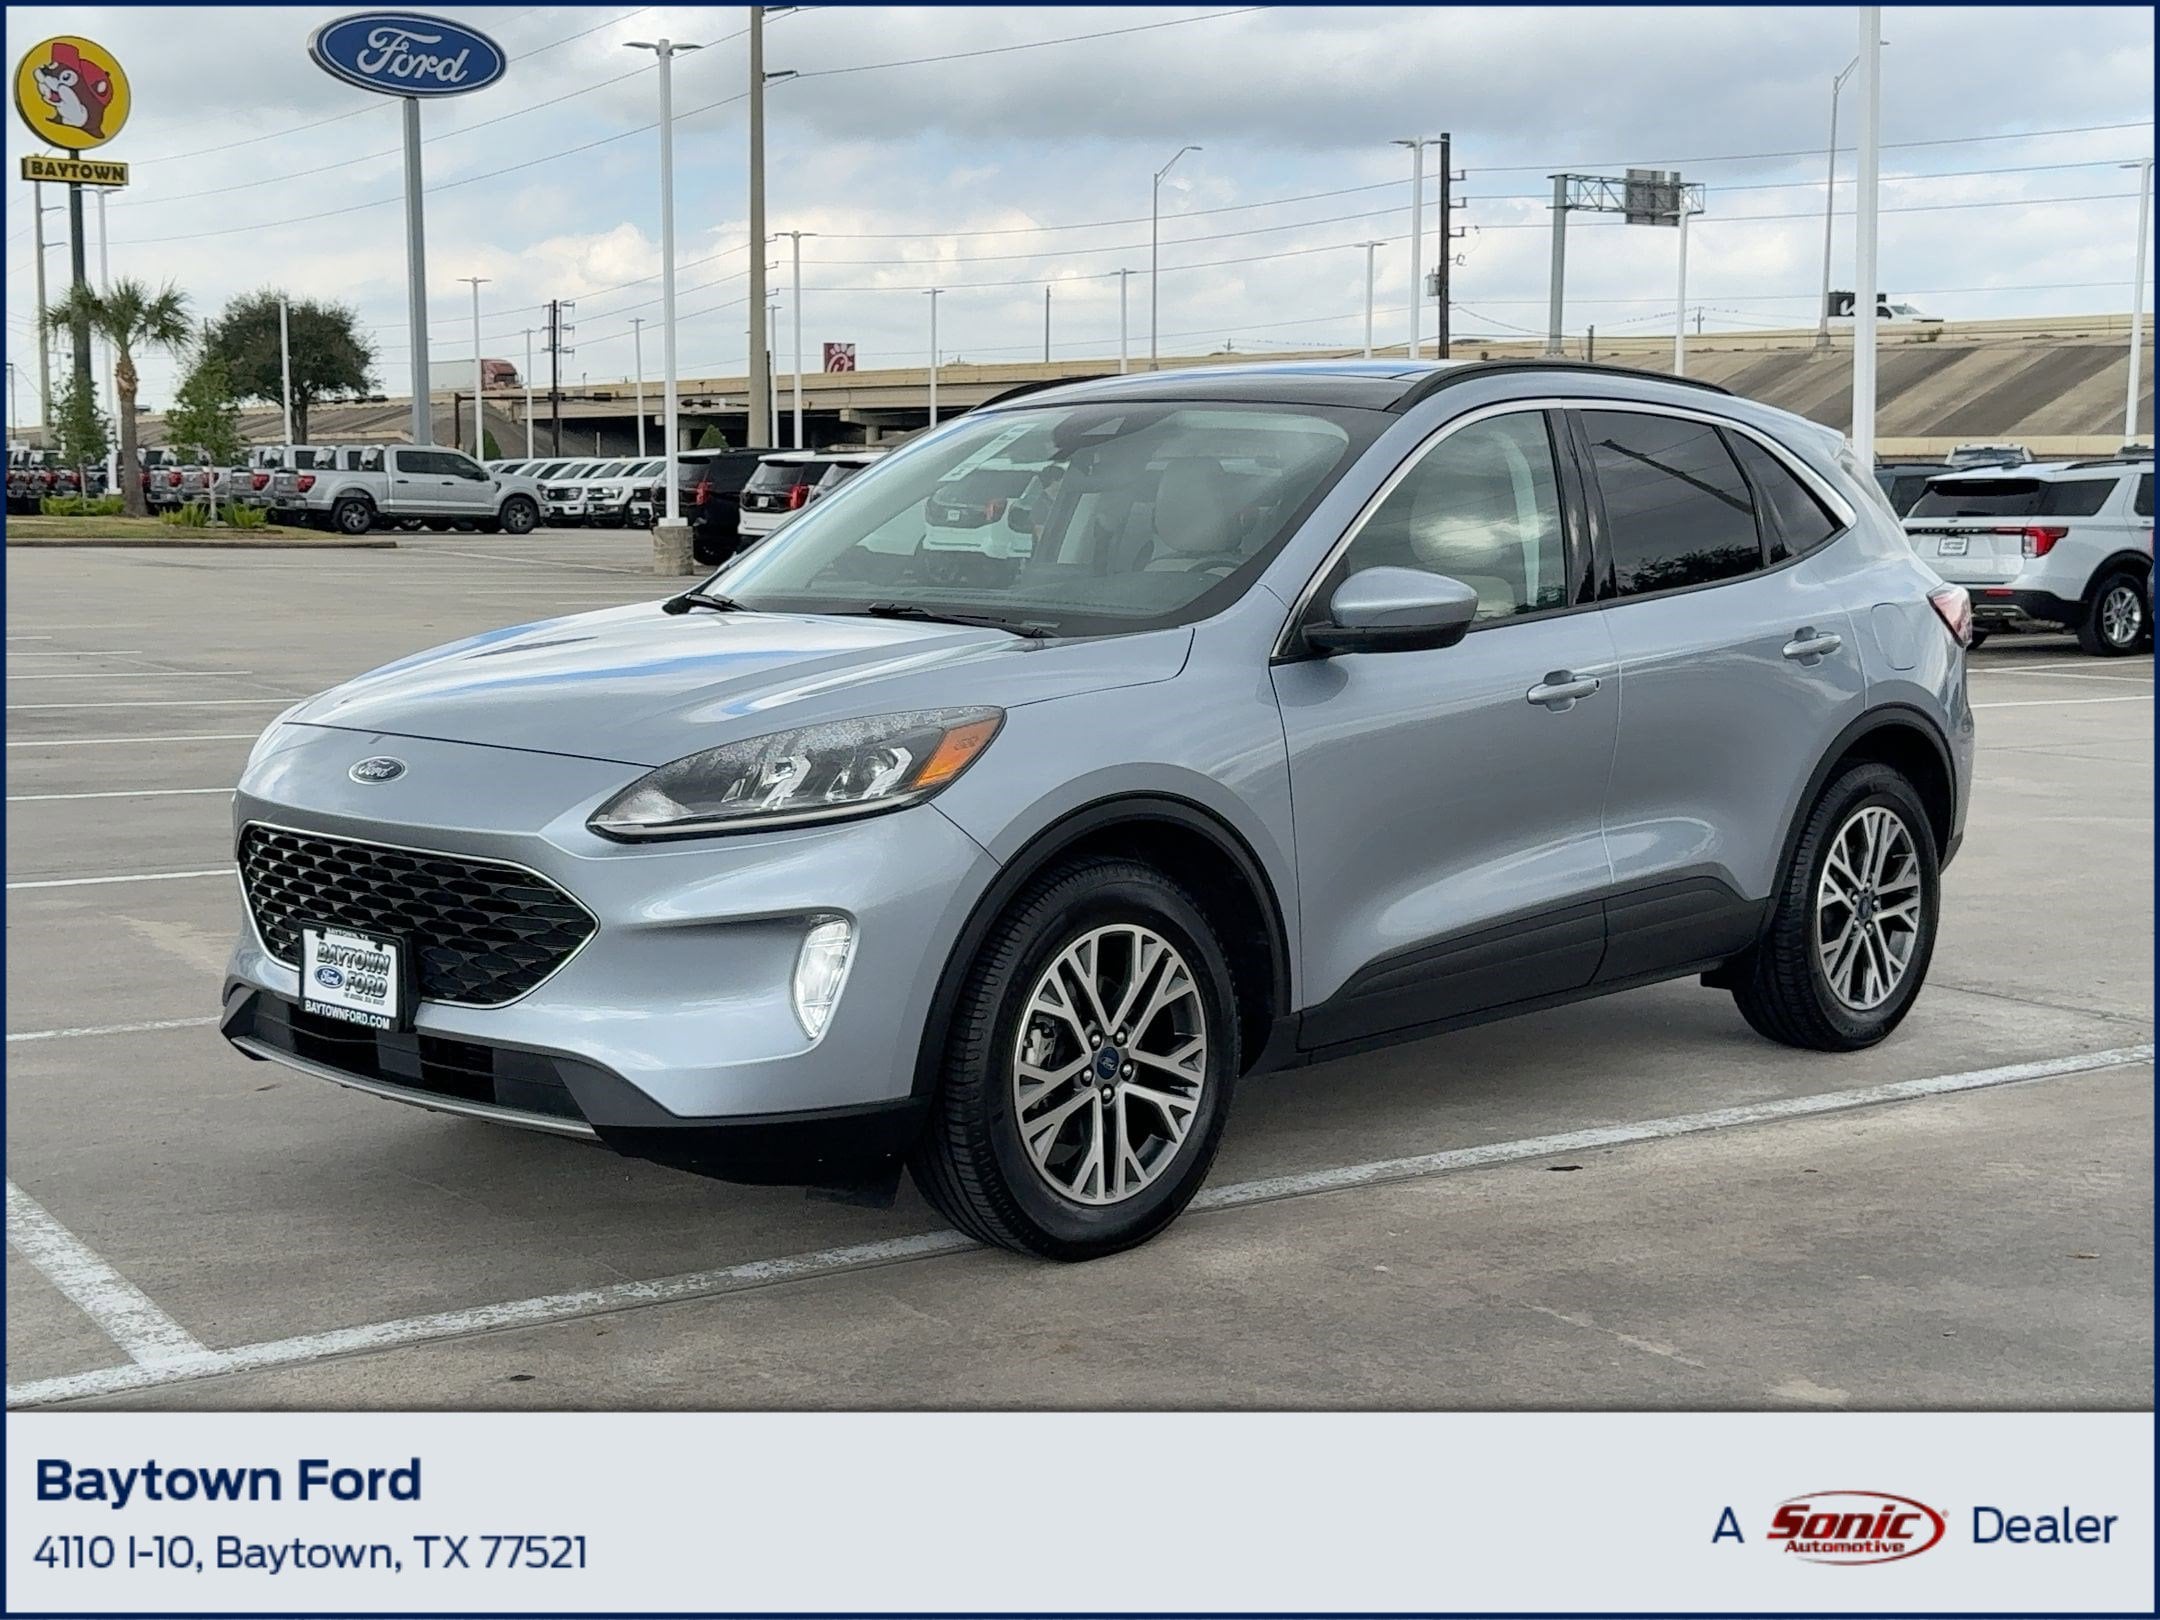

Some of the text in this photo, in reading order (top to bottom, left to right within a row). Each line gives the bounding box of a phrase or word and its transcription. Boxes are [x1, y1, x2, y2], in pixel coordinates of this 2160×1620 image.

[356, 26, 470, 83] Ford
[31, 160, 125, 181] BAYTOWN
[358, 759, 395, 778] Ford
[317, 942, 391, 976] BAYTOWN
[345, 971, 388, 998] FORD
[305, 1000, 390, 1030] BAYTOWNFORD.COM
